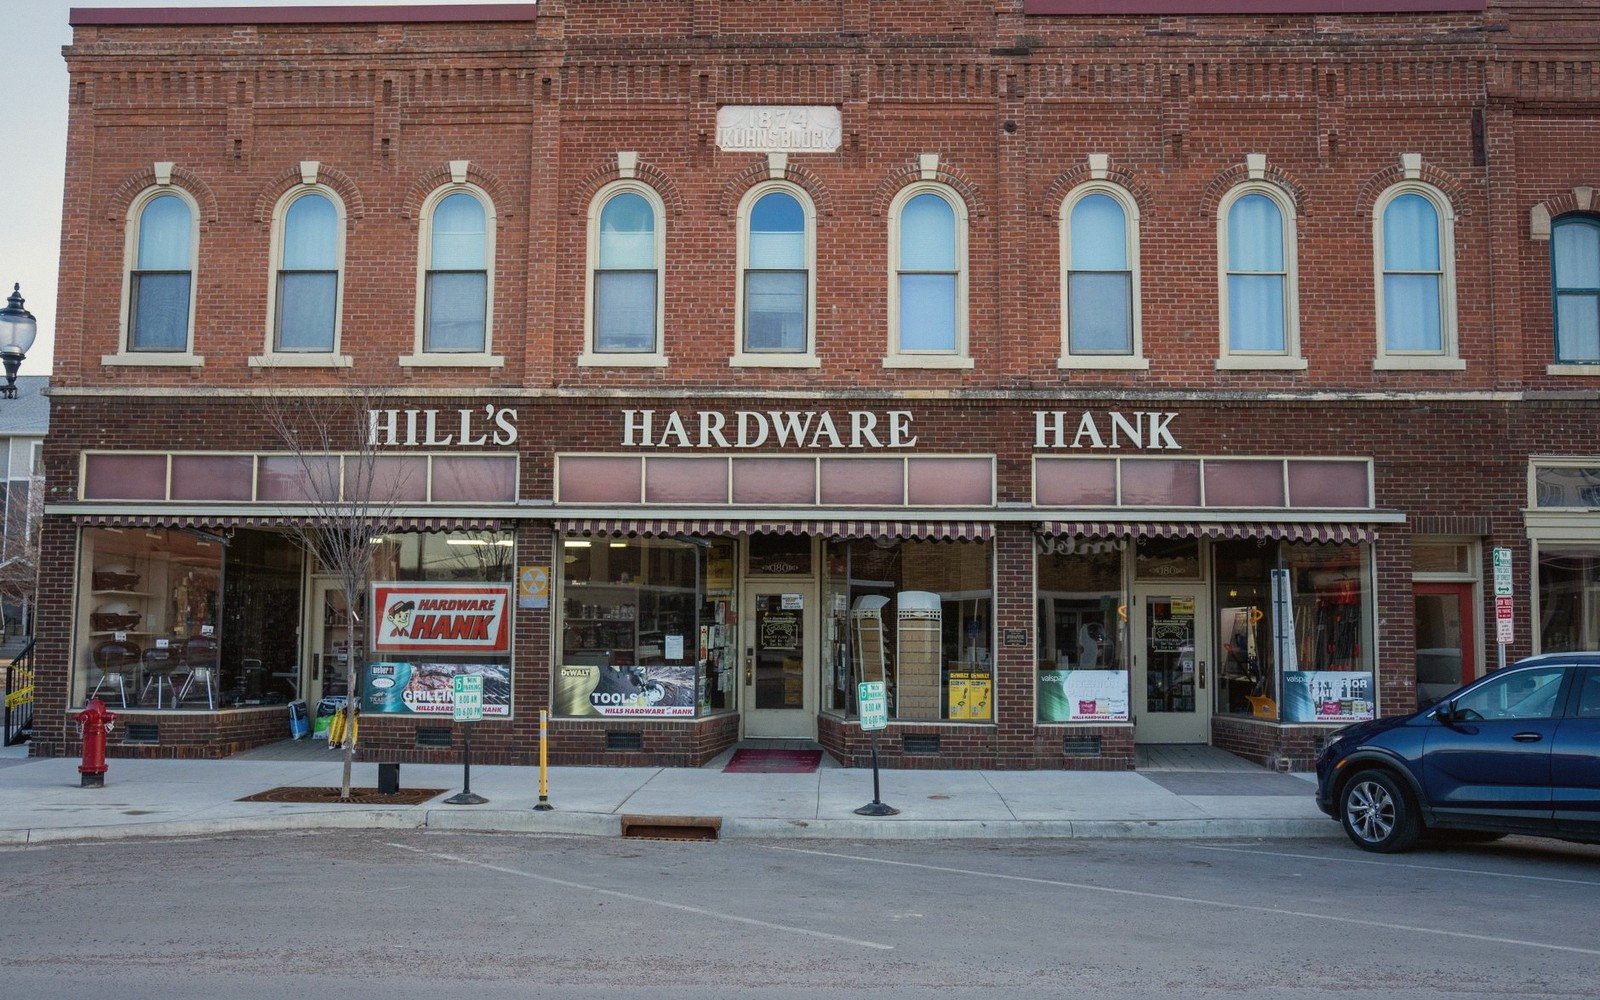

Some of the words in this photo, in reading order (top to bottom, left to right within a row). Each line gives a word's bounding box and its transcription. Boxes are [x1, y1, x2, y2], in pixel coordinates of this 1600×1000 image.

[748, 108, 809, 129] 1874
[780, 128, 835, 148] BLOCK
[367, 403, 518, 446] HILL'S
[620, 409, 918, 448] HARDWARE
[1033, 409, 1183, 449] HANK
[1160, 566, 1176, 575] 180
[418, 599, 496, 611] HARDWARE
[409, 615, 496, 640] HANK
[1041, 674, 1063, 683] valspa
[402, 690, 454, 702] GRILLIN
[592, 692, 638, 704] TOOLS
